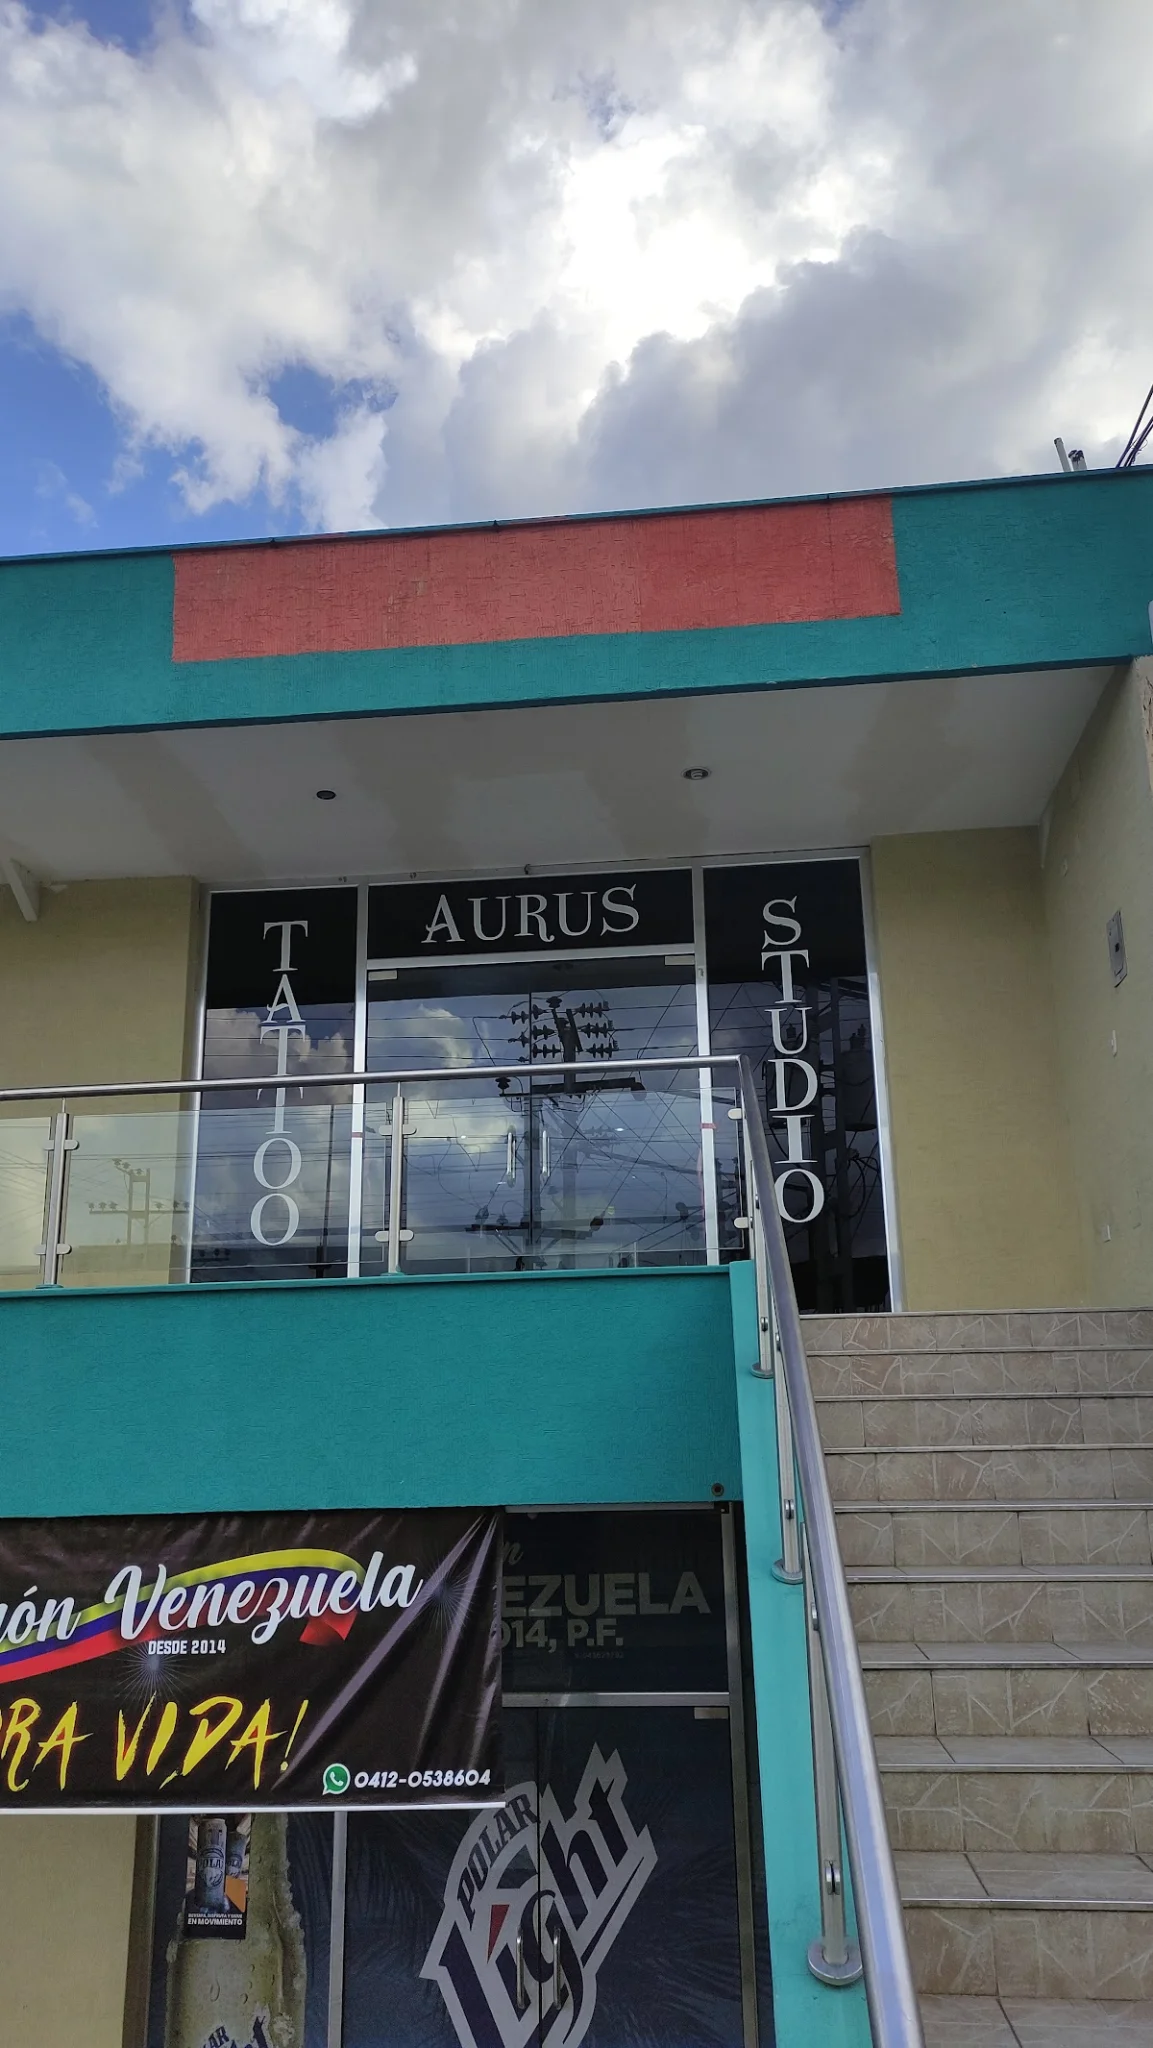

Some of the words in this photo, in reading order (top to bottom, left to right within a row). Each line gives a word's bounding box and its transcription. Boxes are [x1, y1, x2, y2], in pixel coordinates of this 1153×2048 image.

[421, 884, 640, 945] AURUS
[250, 920, 309, 1246] TATTOO
[761, 895, 826, 1223] STUDIO
[104, 1551, 427, 1645] Venezuela
[567, 1617, 624, 1647] P.F.
[148, 1639, 188, 1656] DESDE
[191, 1638, 226, 1655] 2014
[0, 1697, 94, 1792] RA
[116, 1691, 310, 1791] VIDA!
[354, 1768, 492, 1789] 0412-0538604
[457, 1793, 541, 1932] POLAR
[187, 1917, 197, 1925] EN
[198, 1917, 243, 1926] MOVIMIENTO
